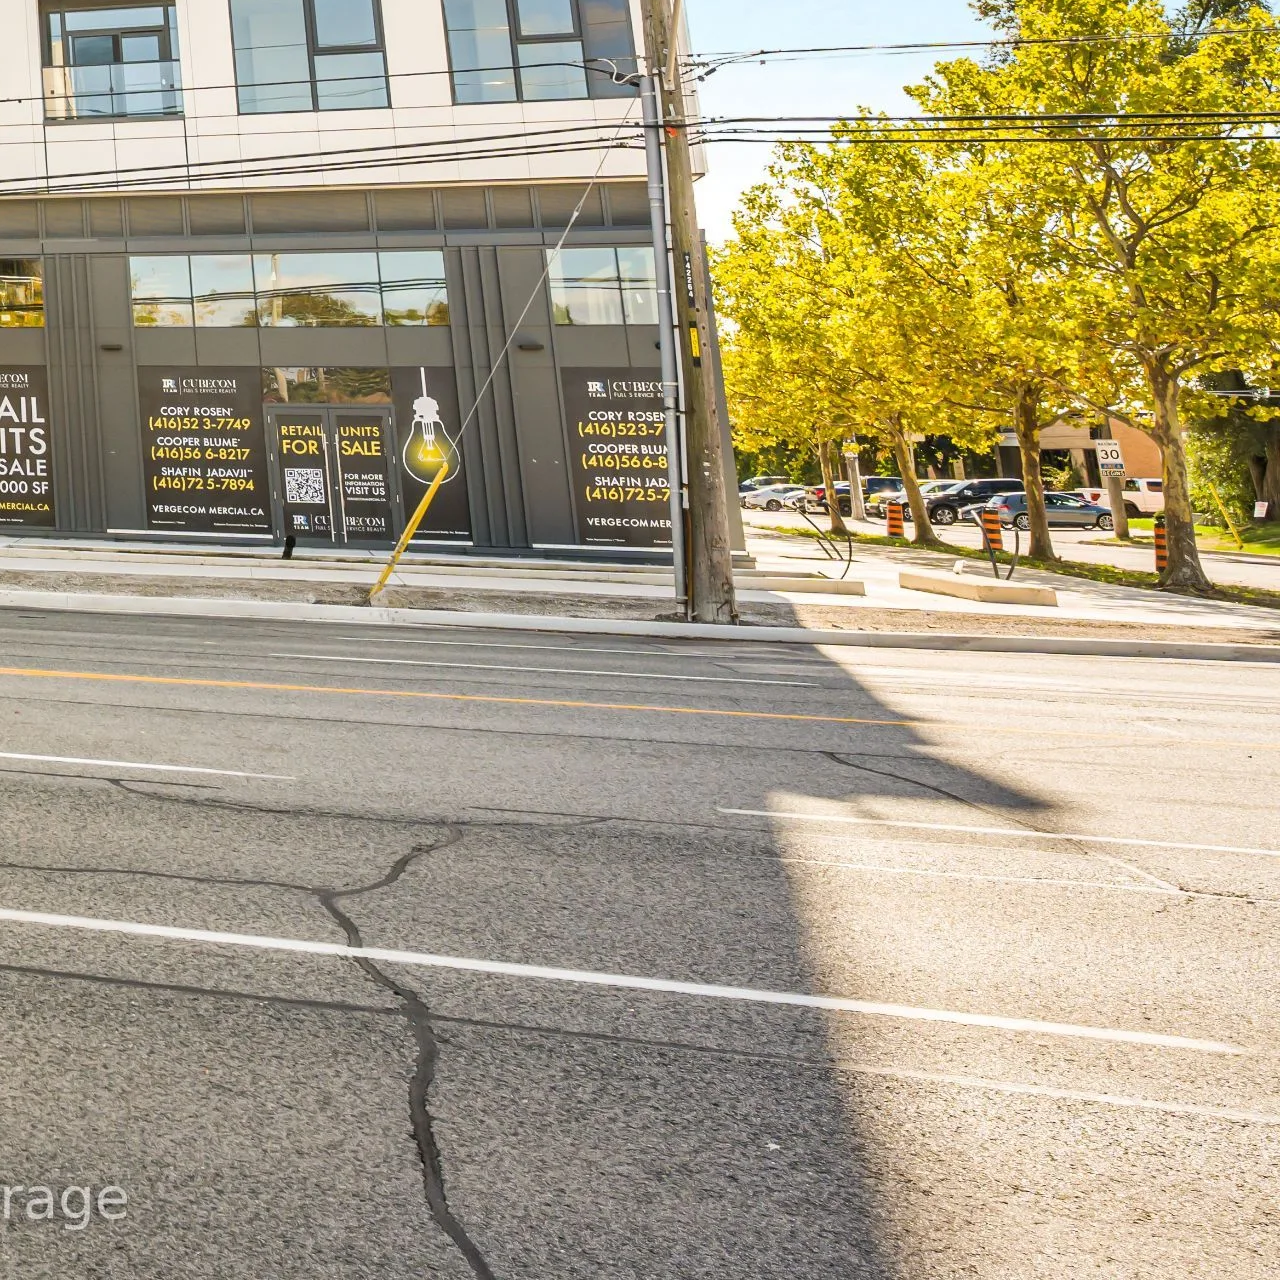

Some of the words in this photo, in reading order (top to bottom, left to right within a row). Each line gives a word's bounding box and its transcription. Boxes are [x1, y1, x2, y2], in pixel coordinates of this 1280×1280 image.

[183, 379, 236, 388] CUBECOM
[160, 406, 190, 416] CORY
[588, 411, 622, 420] CORY
[281, 426, 323, 436] RETAIL
[340, 426, 380, 437] UNITS
[157, 437, 200, 446] COOPER
[282, 440, 319, 454] FOR
[342, 440, 381, 456] SALE
[588, 444, 639, 454] COOPER
[1100, 450, 1119, 459] 30
[162, 467, 200, 476] SHAFIN
[595, 477, 641, 486] SHAFIN
[645, 478, 670, 487] JAD
[32, 482, 49, 494] SF
[345, 487, 370, 495] VISIT
